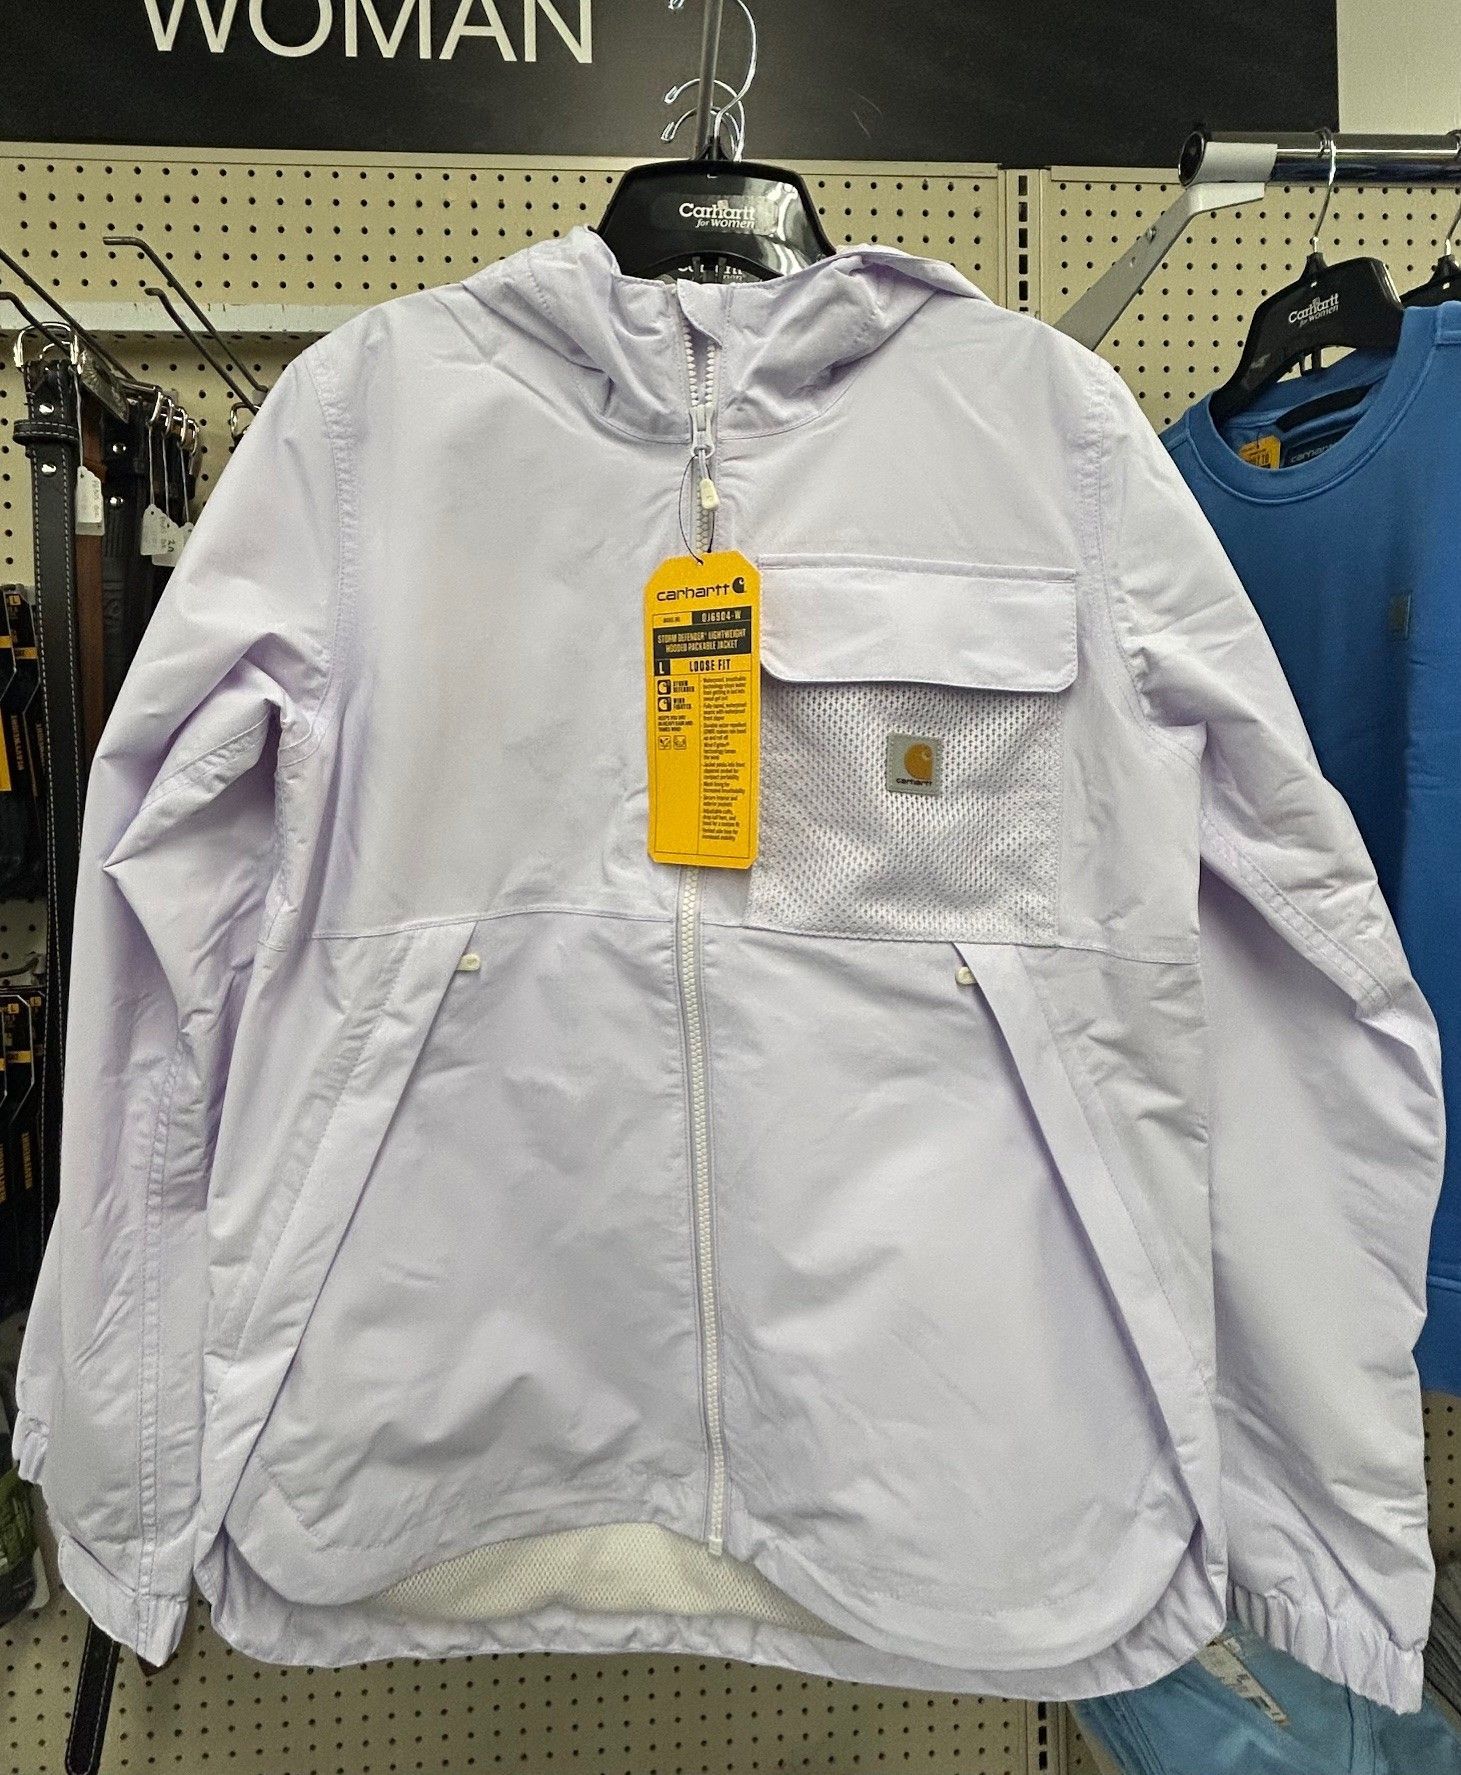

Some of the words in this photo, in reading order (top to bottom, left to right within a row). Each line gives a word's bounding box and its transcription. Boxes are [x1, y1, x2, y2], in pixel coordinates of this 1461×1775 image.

[143, 0, 593, 64] WOMAN
[679, 203, 755, 220] Carhartt
[695, 218, 710, 228] for
[711, 219, 755, 229] women
[1288, 293, 1339, 323] Carhartt
[656, 583, 730, 601] carhartt
[659, 661, 665, 674] L
[689, 660, 715, 672] LOOSE
[718, 659, 730, 670] FIT
